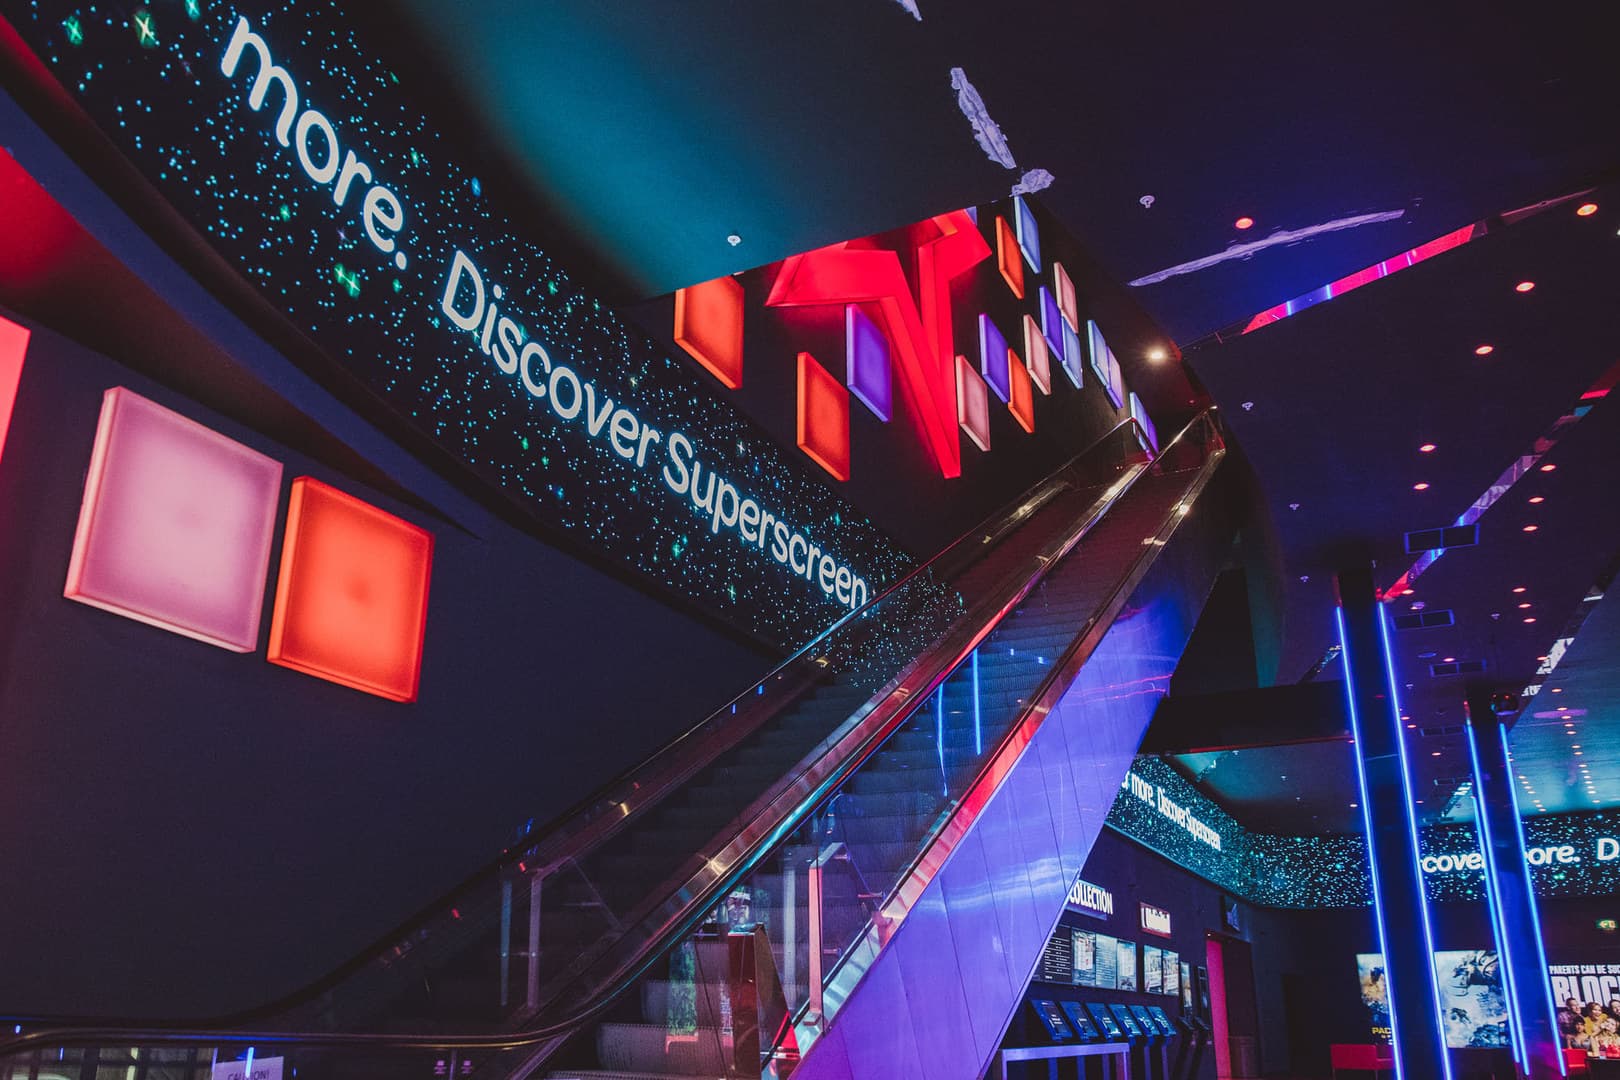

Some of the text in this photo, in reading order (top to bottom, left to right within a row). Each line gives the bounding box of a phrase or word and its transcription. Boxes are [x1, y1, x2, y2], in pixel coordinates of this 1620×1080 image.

[221, 15, 868, 617] more. Discover Superscreen
[1525, 845, 1581, 866] ore.
[1551, 976, 1620, 1007] BLOC
